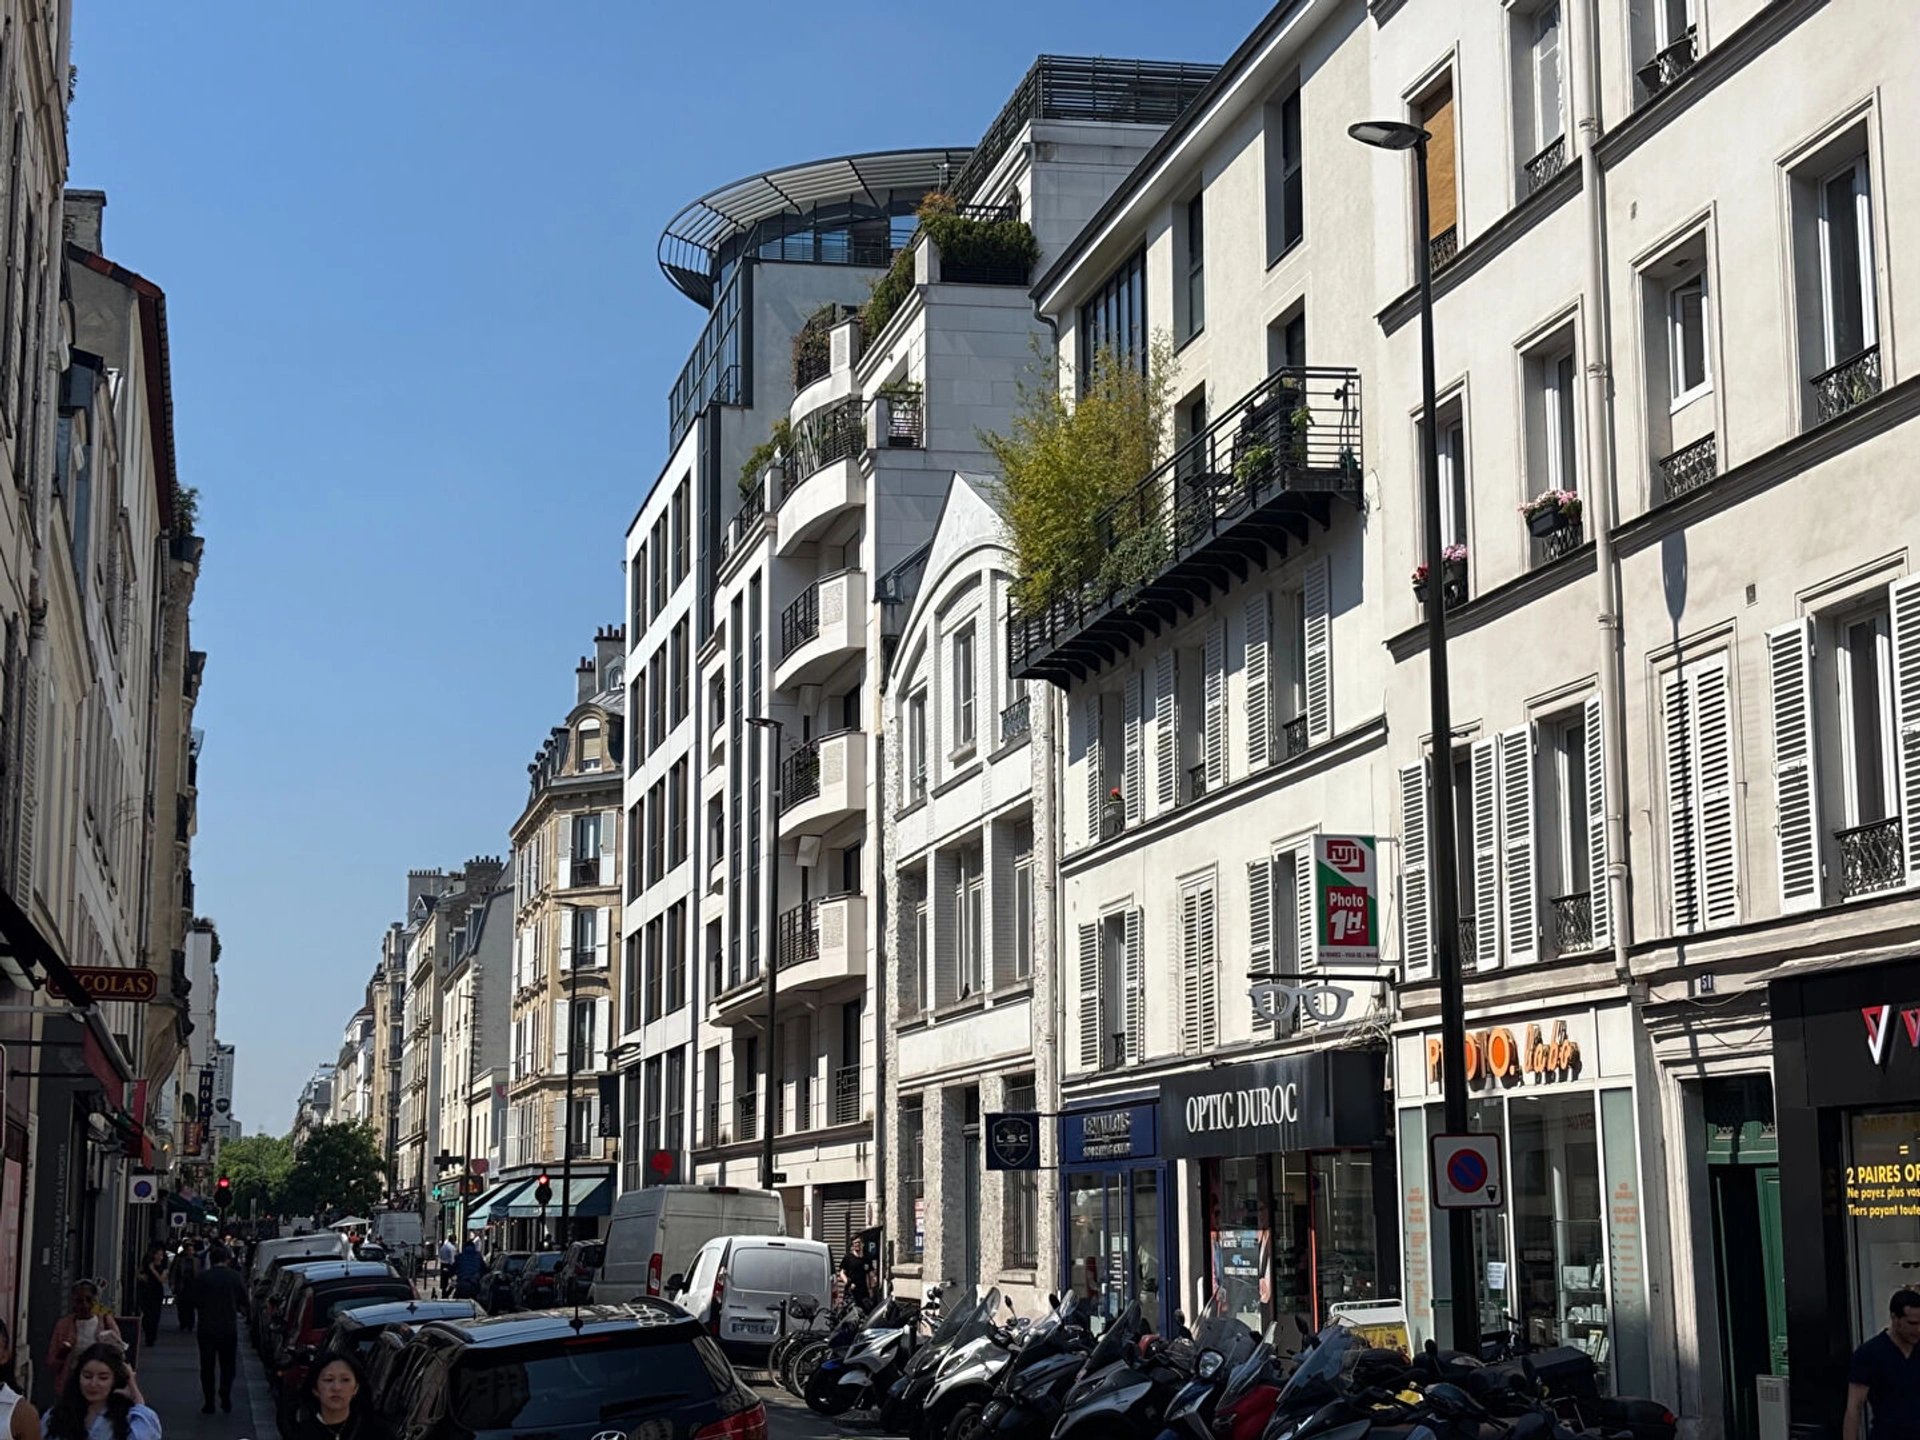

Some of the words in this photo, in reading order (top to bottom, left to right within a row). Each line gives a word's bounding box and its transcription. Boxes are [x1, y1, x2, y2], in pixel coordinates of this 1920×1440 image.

[1329, 844, 1362, 869] FUJI
[1329, 892, 1364, 908] Photo
[56, 974, 149, 993] COLAS
[1701, 974, 1712, 990] 51
[1185, 1091, 1234, 1133] OPTIC
[1236, 1082, 1298, 1128] DUROC
[996, 1134, 1029, 1143] LSC
[1846, 1167, 1855, 1184] 2
[1857, 1164, 1901, 1184] PAIRES
[1847, 1187, 1859, 1198] Ne
[1861, 1189, 1885, 1201] payez
[1887, 1186, 1905, 1200] plus
[1848, 1204, 1868, 1216] Tiers
[1869, 1205, 1898, 1219] payant
